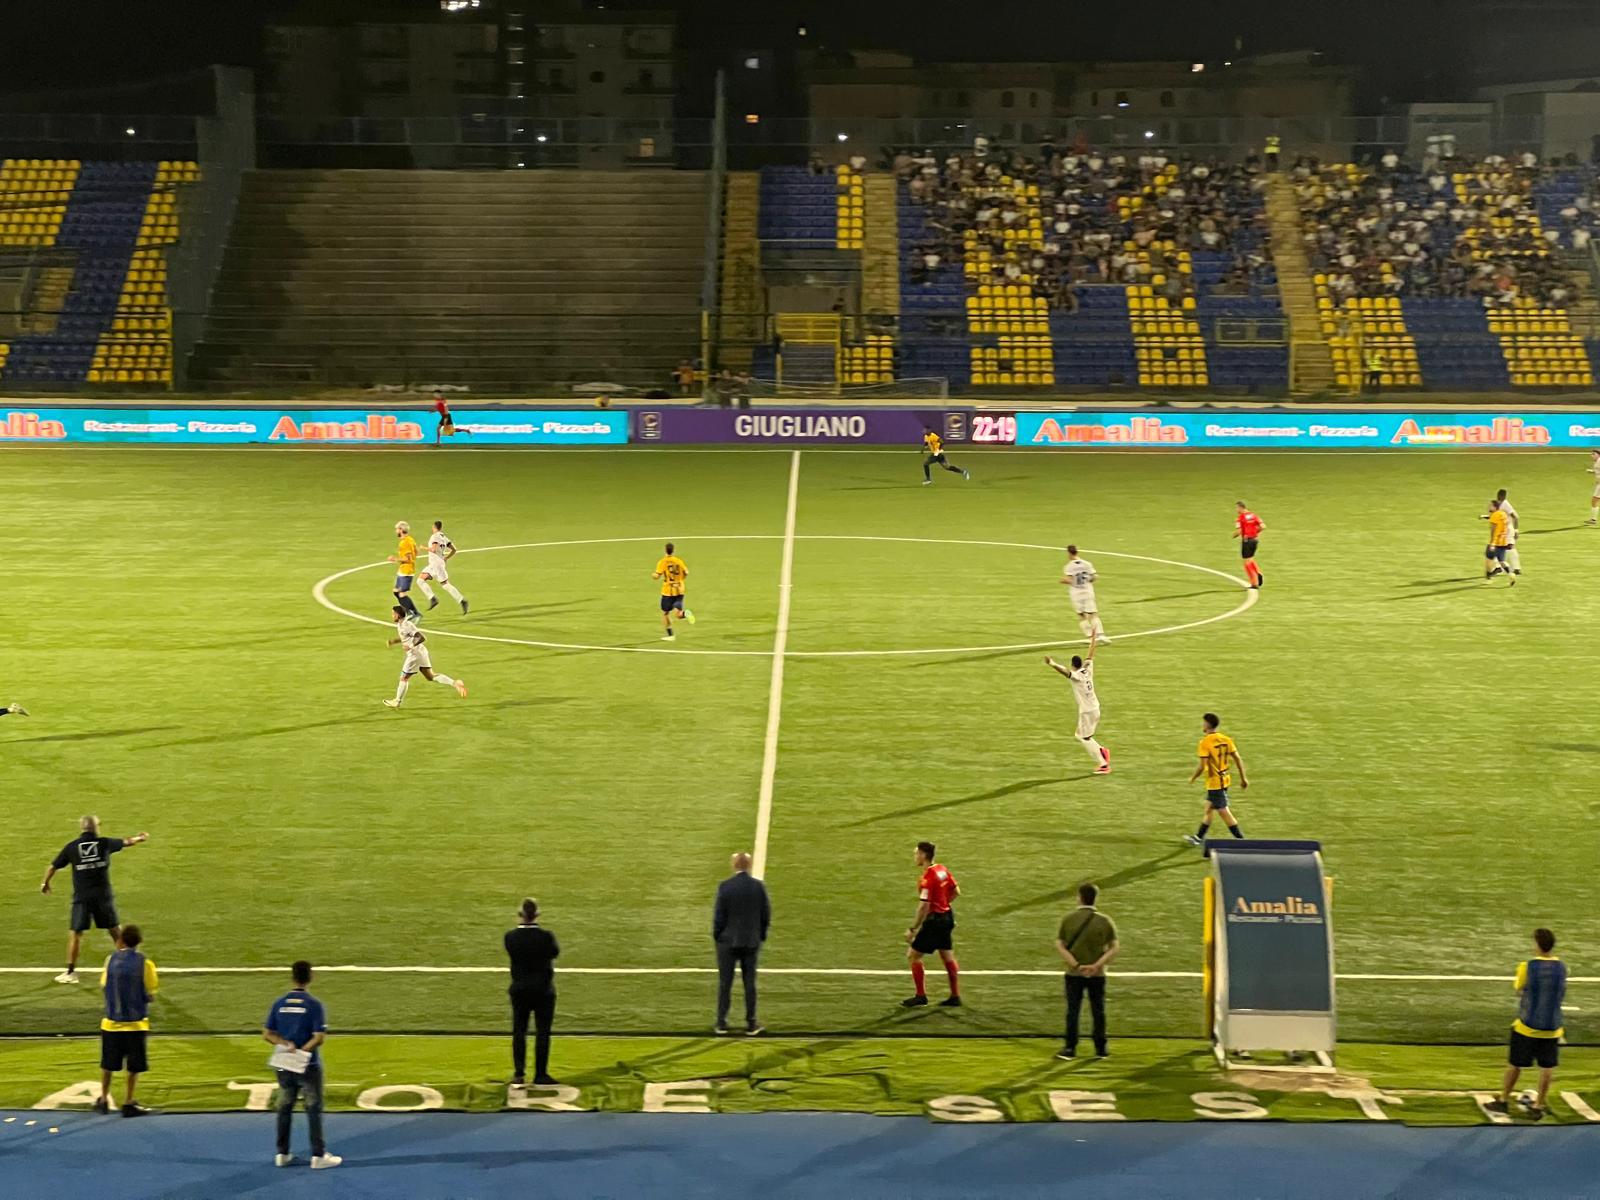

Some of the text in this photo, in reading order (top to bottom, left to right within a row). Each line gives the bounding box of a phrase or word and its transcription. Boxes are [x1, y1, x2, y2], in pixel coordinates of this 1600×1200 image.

[187, 420, 257, 434] Pizzeria
[267, 414, 424, 441] Amalia
[543, 422, 611, 434] Pizzeria
[735, 415, 866, 438] GIUGLIANO
[972, 416, 1016, 441] 22:19
[1032, 417, 1189, 443] Amalia
[1309, 425, 1378, 437] Pizzeria
[1390, 417, 1552, 444] Amalia
[1232, 896, 1319, 915] Amalia
